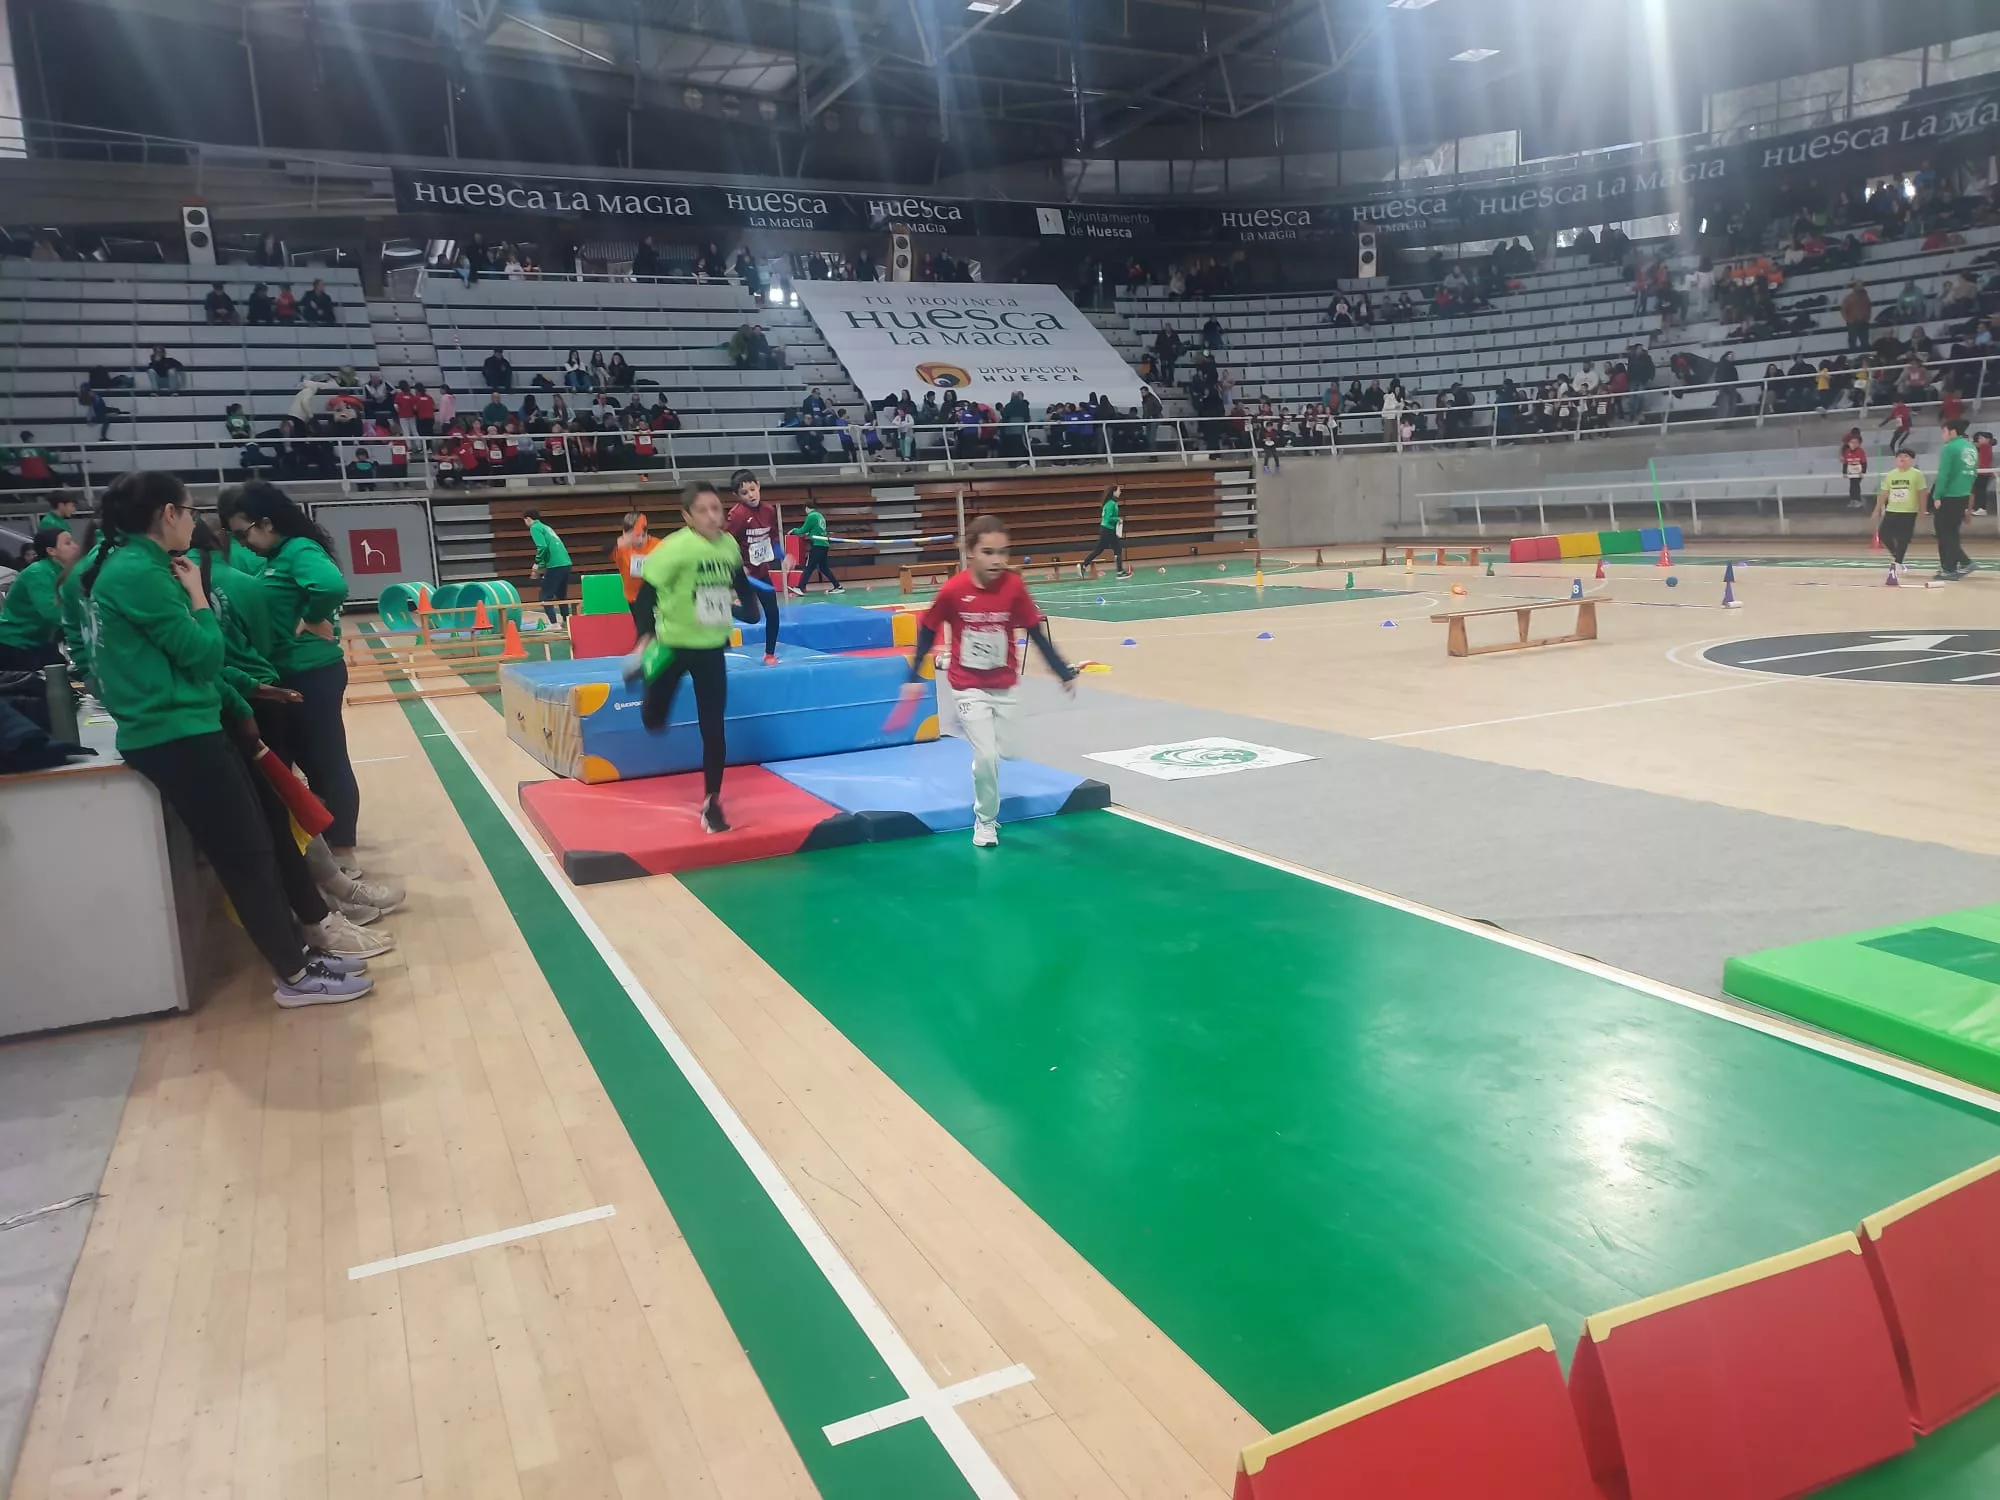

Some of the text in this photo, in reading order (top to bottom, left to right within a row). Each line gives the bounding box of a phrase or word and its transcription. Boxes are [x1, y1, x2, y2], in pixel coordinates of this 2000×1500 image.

[1067, 208, 1151, 225] Ayuntamiento
[1068, 223, 1133, 239] de Huesca
[982, 374, 1085, 383] HUESCA
[1573, 584, 1580, 594] 8
